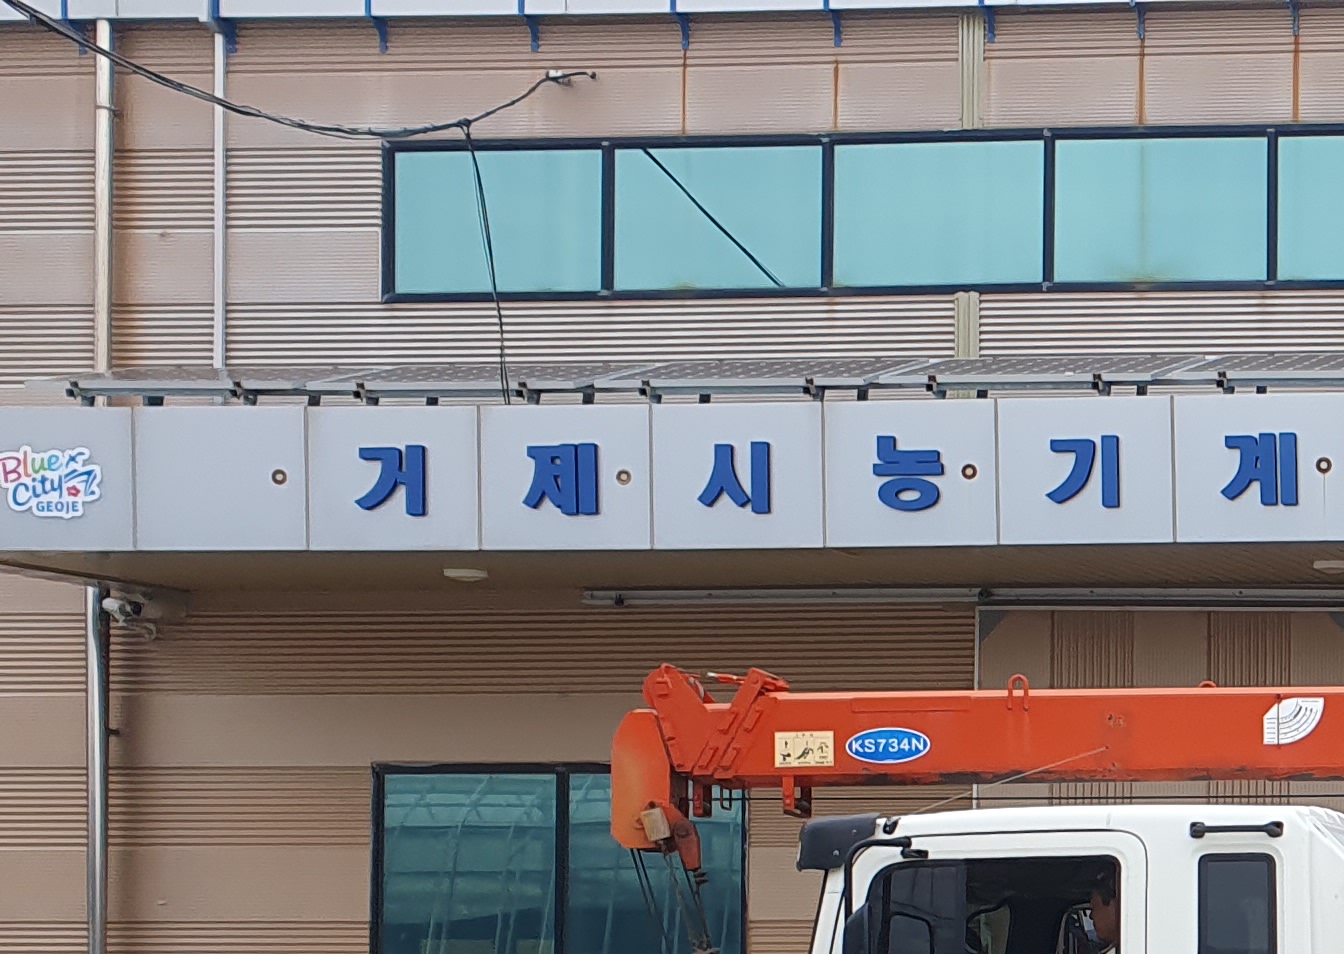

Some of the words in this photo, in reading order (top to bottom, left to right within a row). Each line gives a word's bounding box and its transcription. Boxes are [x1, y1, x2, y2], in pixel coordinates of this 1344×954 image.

[0, 449, 63, 484] Blue
[12, 474, 63, 507] City
[36, 501, 80, 515] GEOJE
[852, 737, 925, 753] KS734N
